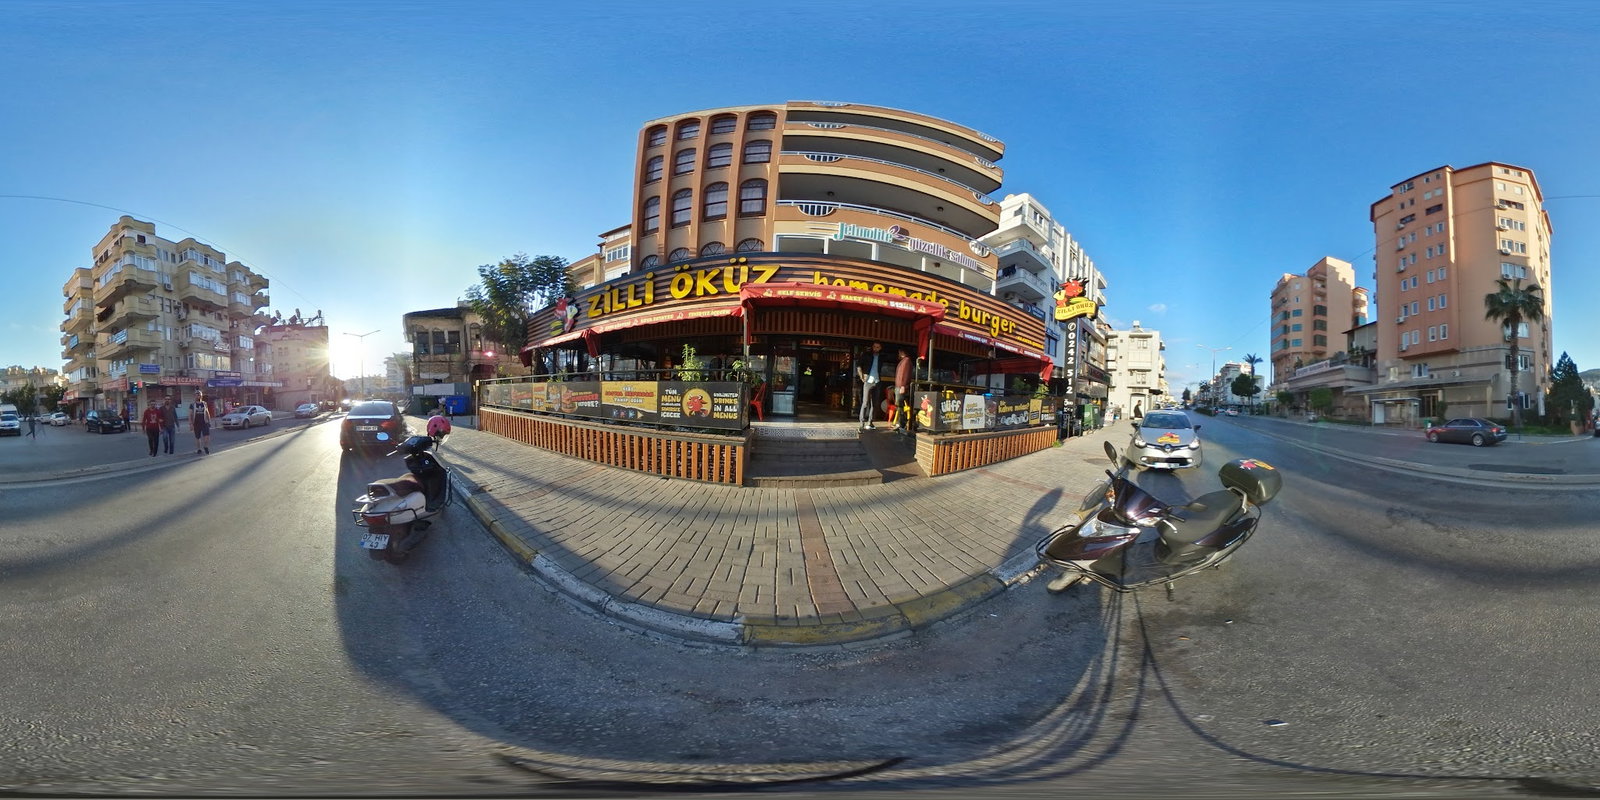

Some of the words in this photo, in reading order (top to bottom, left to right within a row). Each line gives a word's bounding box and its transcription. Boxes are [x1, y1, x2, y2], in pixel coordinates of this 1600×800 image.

[587, 272, 655, 318] ZİLLİ
[670, 257, 781, 299] ÖKÜZ
[959, 300, 1016, 337] burger
[1067, 332, 1076, 364] 0242
[1066, 369, 1074, 394] 512
[724, 404, 738, 412] ALL
